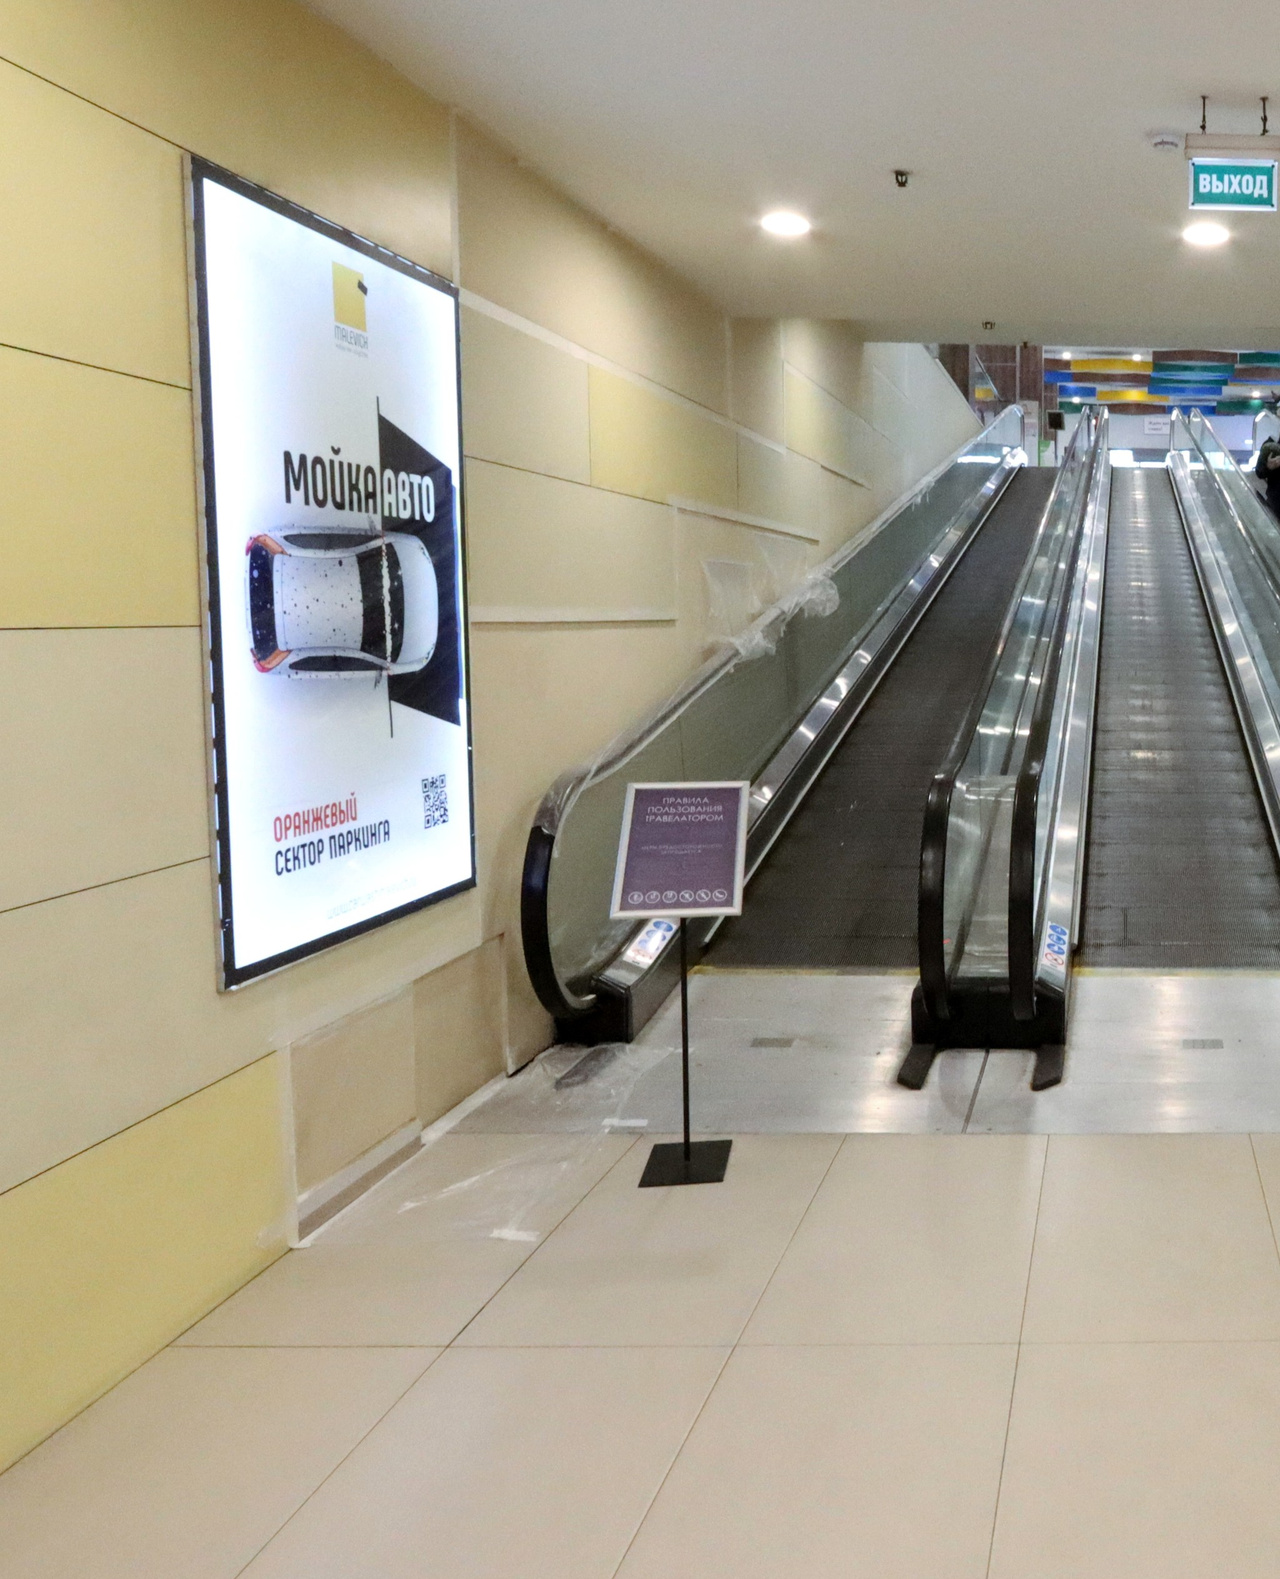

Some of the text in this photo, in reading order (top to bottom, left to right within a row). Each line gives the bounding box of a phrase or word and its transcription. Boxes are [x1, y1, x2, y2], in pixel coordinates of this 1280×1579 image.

[1199, 173, 1269, 198] ВЫХОД
[283, 446, 436, 523] МОЙКА АВТО
[273, 792, 358, 842] ОРАНЖЕВЫЙ
[645, 814, 724, 822] ТРАВЕЛАТОРОМ
[647, 805, 723, 813] ПОЛЬЗОВАНИЯ
[275, 819, 391, 876] СЕКТОР ПАРКИНГА
